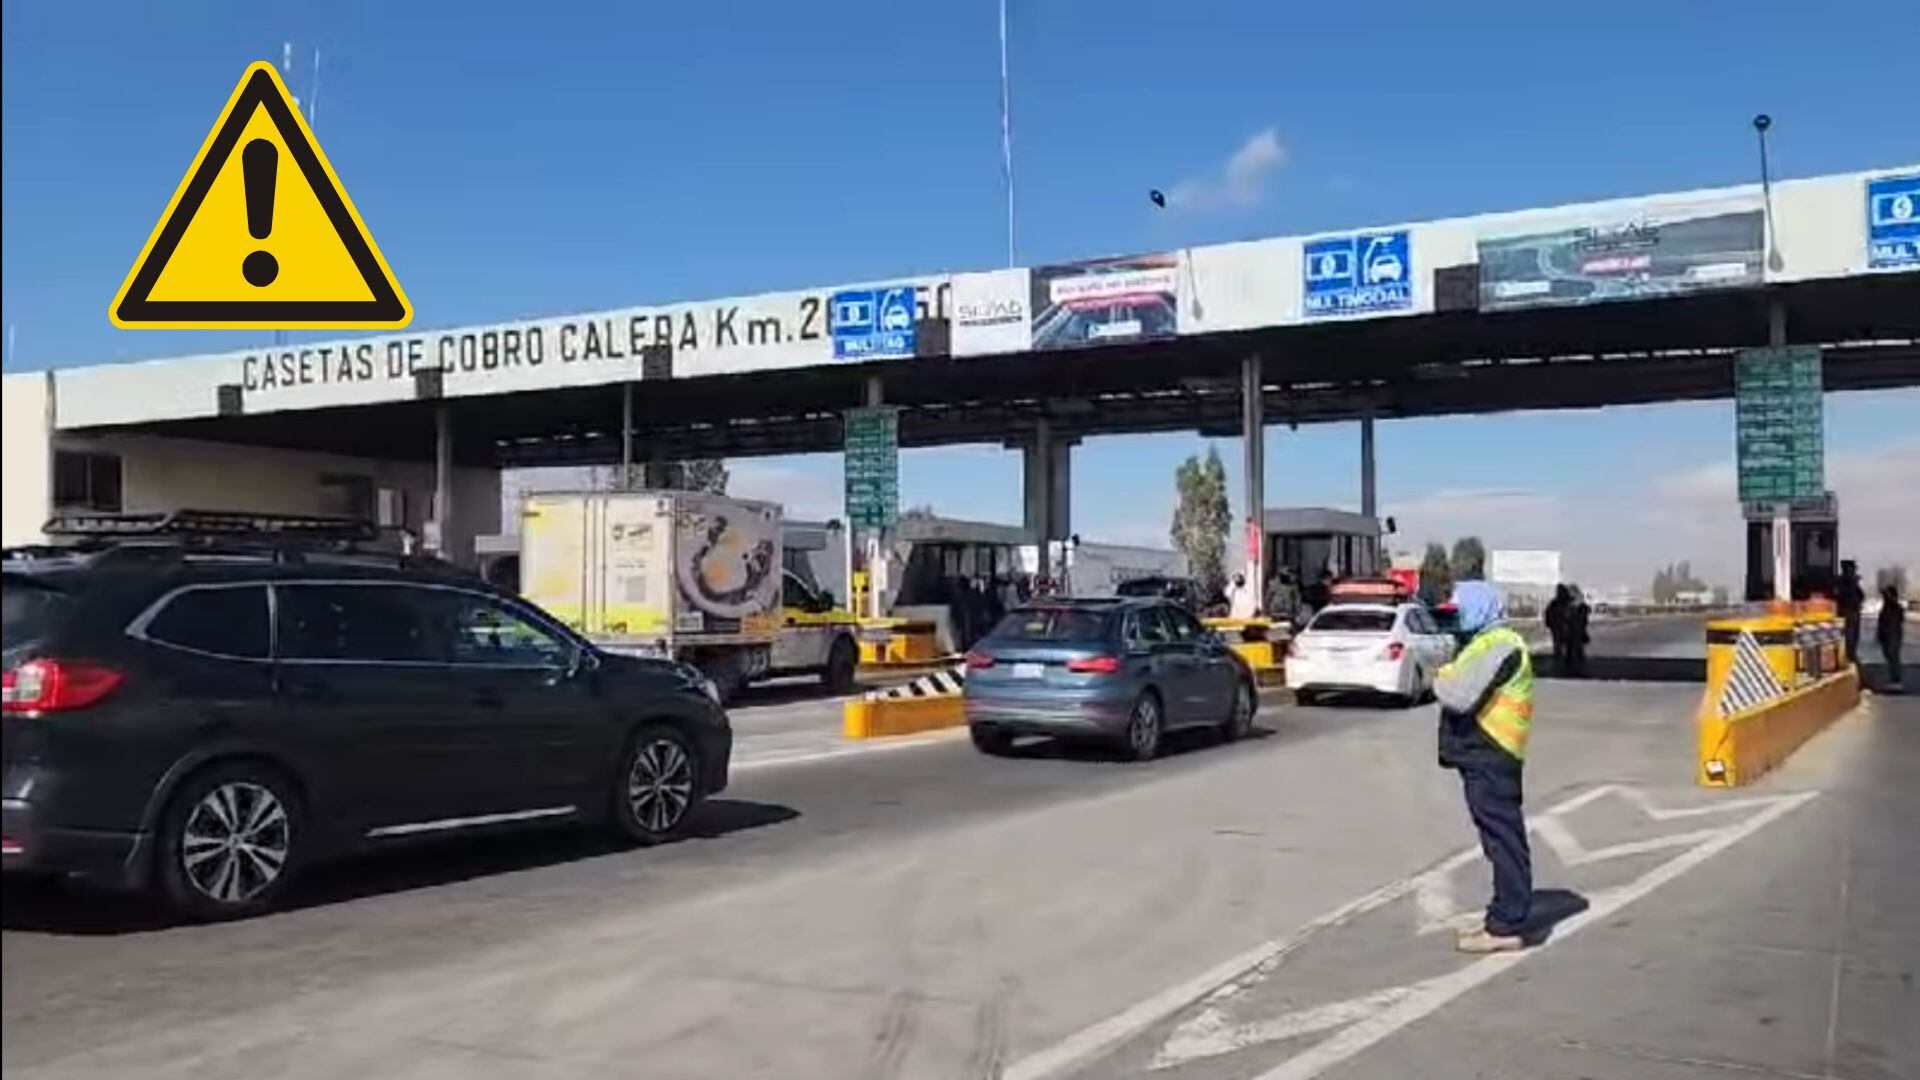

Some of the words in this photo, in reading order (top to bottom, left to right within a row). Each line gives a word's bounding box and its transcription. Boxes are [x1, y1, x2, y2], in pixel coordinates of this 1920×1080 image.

[243, 344, 373, 391] CASETAS
[386, 339, 424, 380] DE
[439, 326, 544, 376] COBRO
[559, 311, 698, 362] CALERA
